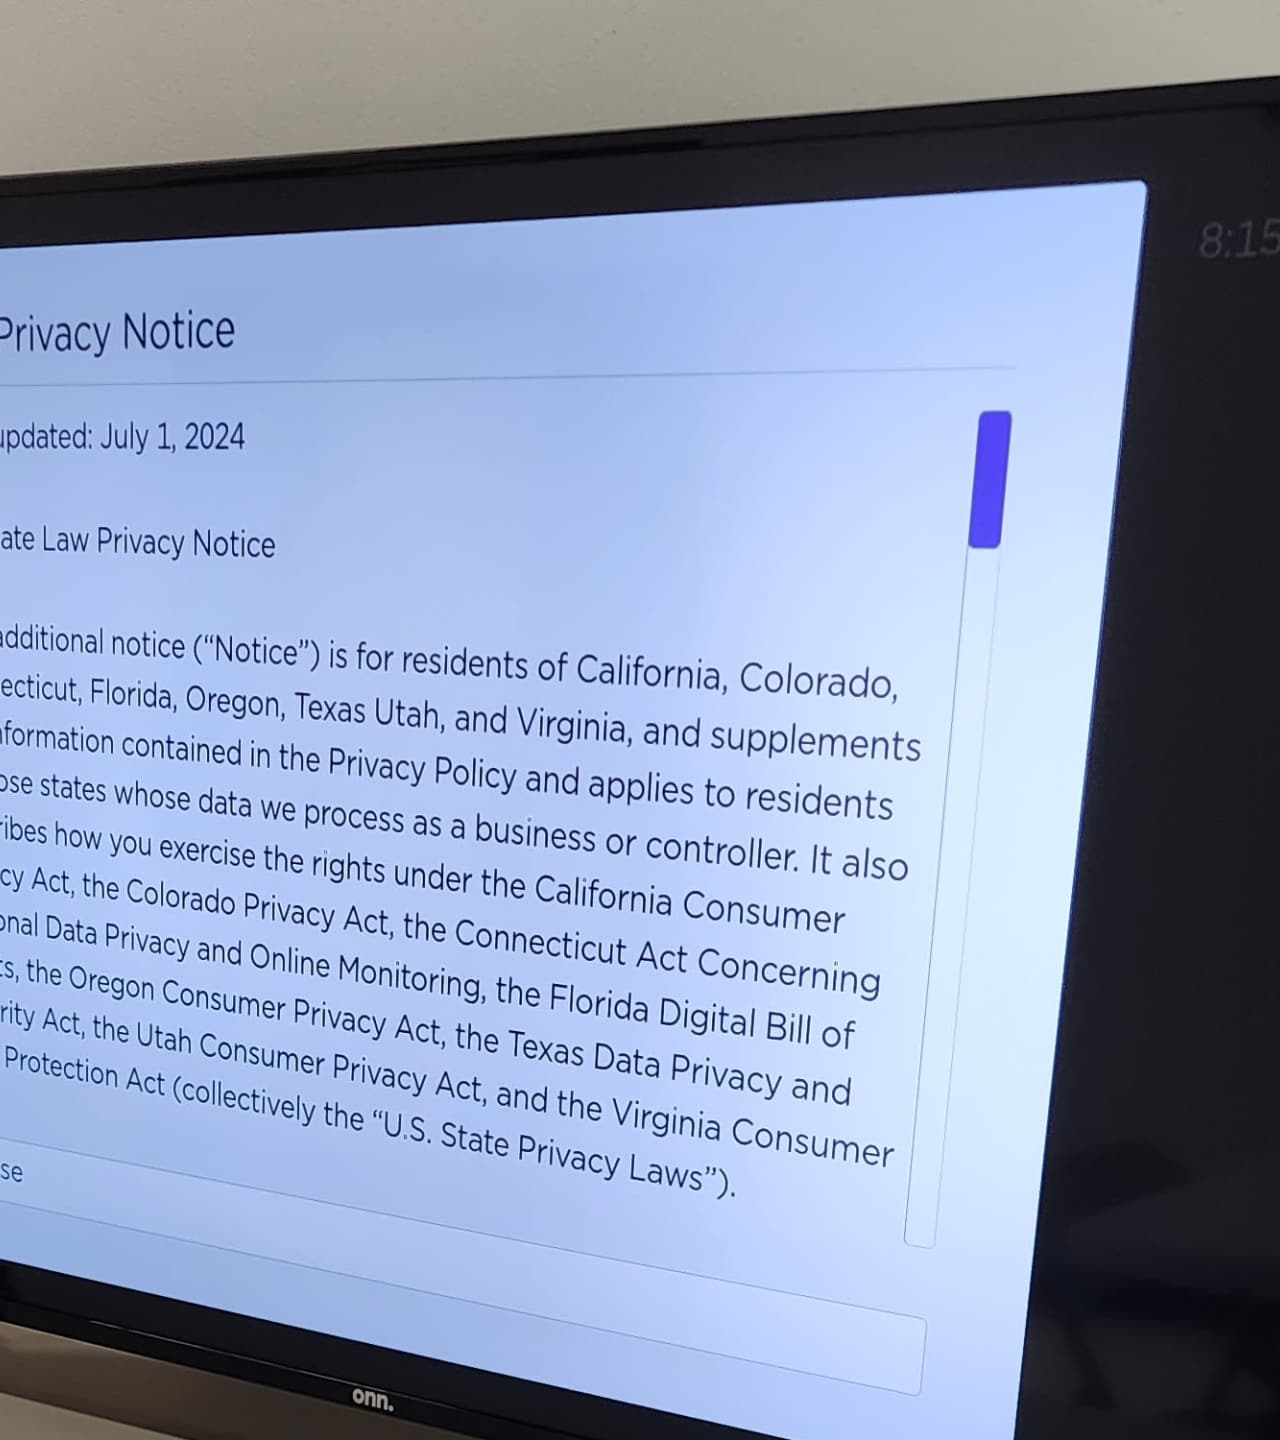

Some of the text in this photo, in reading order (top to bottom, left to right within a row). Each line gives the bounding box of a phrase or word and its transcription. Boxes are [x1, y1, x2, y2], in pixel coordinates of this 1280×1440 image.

[123, 307, 236, 351] Notice
[99, 419, 150, 455] July
[156, 421, 176, 454] 1,
[183, 420, 246, 450] 2024
[42, 523, 90, 553] Law
[96, 524, 186, 562] Privacy
[192, 527, 276, 559] Notice
[110, 628, 186, 660] notice
[328, 638, 348, 669] is
[355, 639, 395, 673] for
[401, 643, 528, 680] residents
[536, 649, 569, 683] of
[575, 652, 728, 696] California,
[739, 660, 898, 705] Colorado,
[90, 676, 178, 714] Florida,
[185, 683, 286, 723] Oregon,
[292, 690, 366, 724] Texas
[374, 696, 445, 735] Utah,
[453, 702, 508, 735] and
[515, 705, 633, 748] Virginia,
[642, 716, 701, 748] and
[709, 721, 922, 763] supplements
[120, 732, 242, 766] contained
[249, 738, 271, 769] in
[278, 741, 321, 773] the
[328, 745, 426, 788] Privacy
[434, 754, 518, 796] Policy
[524, 764, 580, 796] and
[587, 769, 694, 806] applies
[703, 776, 736, 808] to
[745, 781, 894, 821] residents
[39, 772, 107, 803] states
[112, 778, 191, 811] whose
[197, 785, 252, 818] data
[259, 798, 297, 822] we
[303, 802, 405, 834] process
[411, 813, 442, 837] as
[449, 817, 465, 840] a
[474, 811, 596, 853] business
[604, 832, 638, 857] or
[645, 834, 799, 873] controller.
[810, 842, 833, 876] It
[840, 845, 909, 882] also
[54, 819, 103, 851] how
[108, 831, 152, 858] you
[158, 837, 256, 869] exercise
[262, 842, 305, 874] the
[311, 848, 385, 884] rights
[393, 860, 474, 894] under
[479, 866, 526, 900] the
[534, 873, 672, 917] California
[682, 888, 847, 934] Consumer
[30, 864, 75, 899] Act,
[80, 870, 120, 901] the
[125, 876, 236, 916] Colorado
[243, 890, 336, 934] Privacy
[342, 903, 394, 941] Act,
[402, 910, 447, 943] the
[454, 917, 628, 966] Connecticut
[634, 939, 689, 974] Act
[696, 946, 881, 1002] Concerning
[45, 913, 98, 946] Data
[104, 921, 190, 963] Privacy
[195, 938, 242, 966] and
[249, 942, 331, 978] Online
[338, 952, 487, 1005] Monitoring,
[494, 975, 541, 1008] the
[549, 982, 649, 1024] Florida
[659, 995, 756, 1038] Digital
[765, 1009, 812, 1045] Bill
[820, 1018, 857, 1051] of
[24, 957, 62, 986] the
[68, 964, 154, 1001] Oregon
[161, 978, 287, 1021] Consumer
[293, 996, 387, 1042] Privacy
[393, 1013, 446, 1050] Act,
[454, 1021, 499, 1054] the
[506, 1028, 584, 1067] Texas
[593, 1040, 660, 1079] Data
[670, 1052, 783, 1101] Privacy
[790, 1075, 852, 1107] and
[4, 1044, 118, 1089] Protection
[124, 1065, 166, 1096] Act
[171, 1074, 317, 1127] (collectively
[322, 1099, 365, 1132] the
[440, 1120, 510, 1157] State
[517, 1133, 621, 1182] Privacy
[41, 1006, 85, 1040] Act,
[91, 1014, 130, 1044] the
[136, 1020, 192, 1054] Utah
[198, 1031, 326, 1076] Consumer
[332, 1051, 428, 1098] Privacy
[434, 1069, 487, 1108] Act,
[495, 1084, 548, 1114] and
[556, 1088, 603, 1122] the
[611, 1096, 721, 1142] Virginia
[731, 1116, 896, 1168] Consumer
[352, 1388, 394, 1412] onn.
